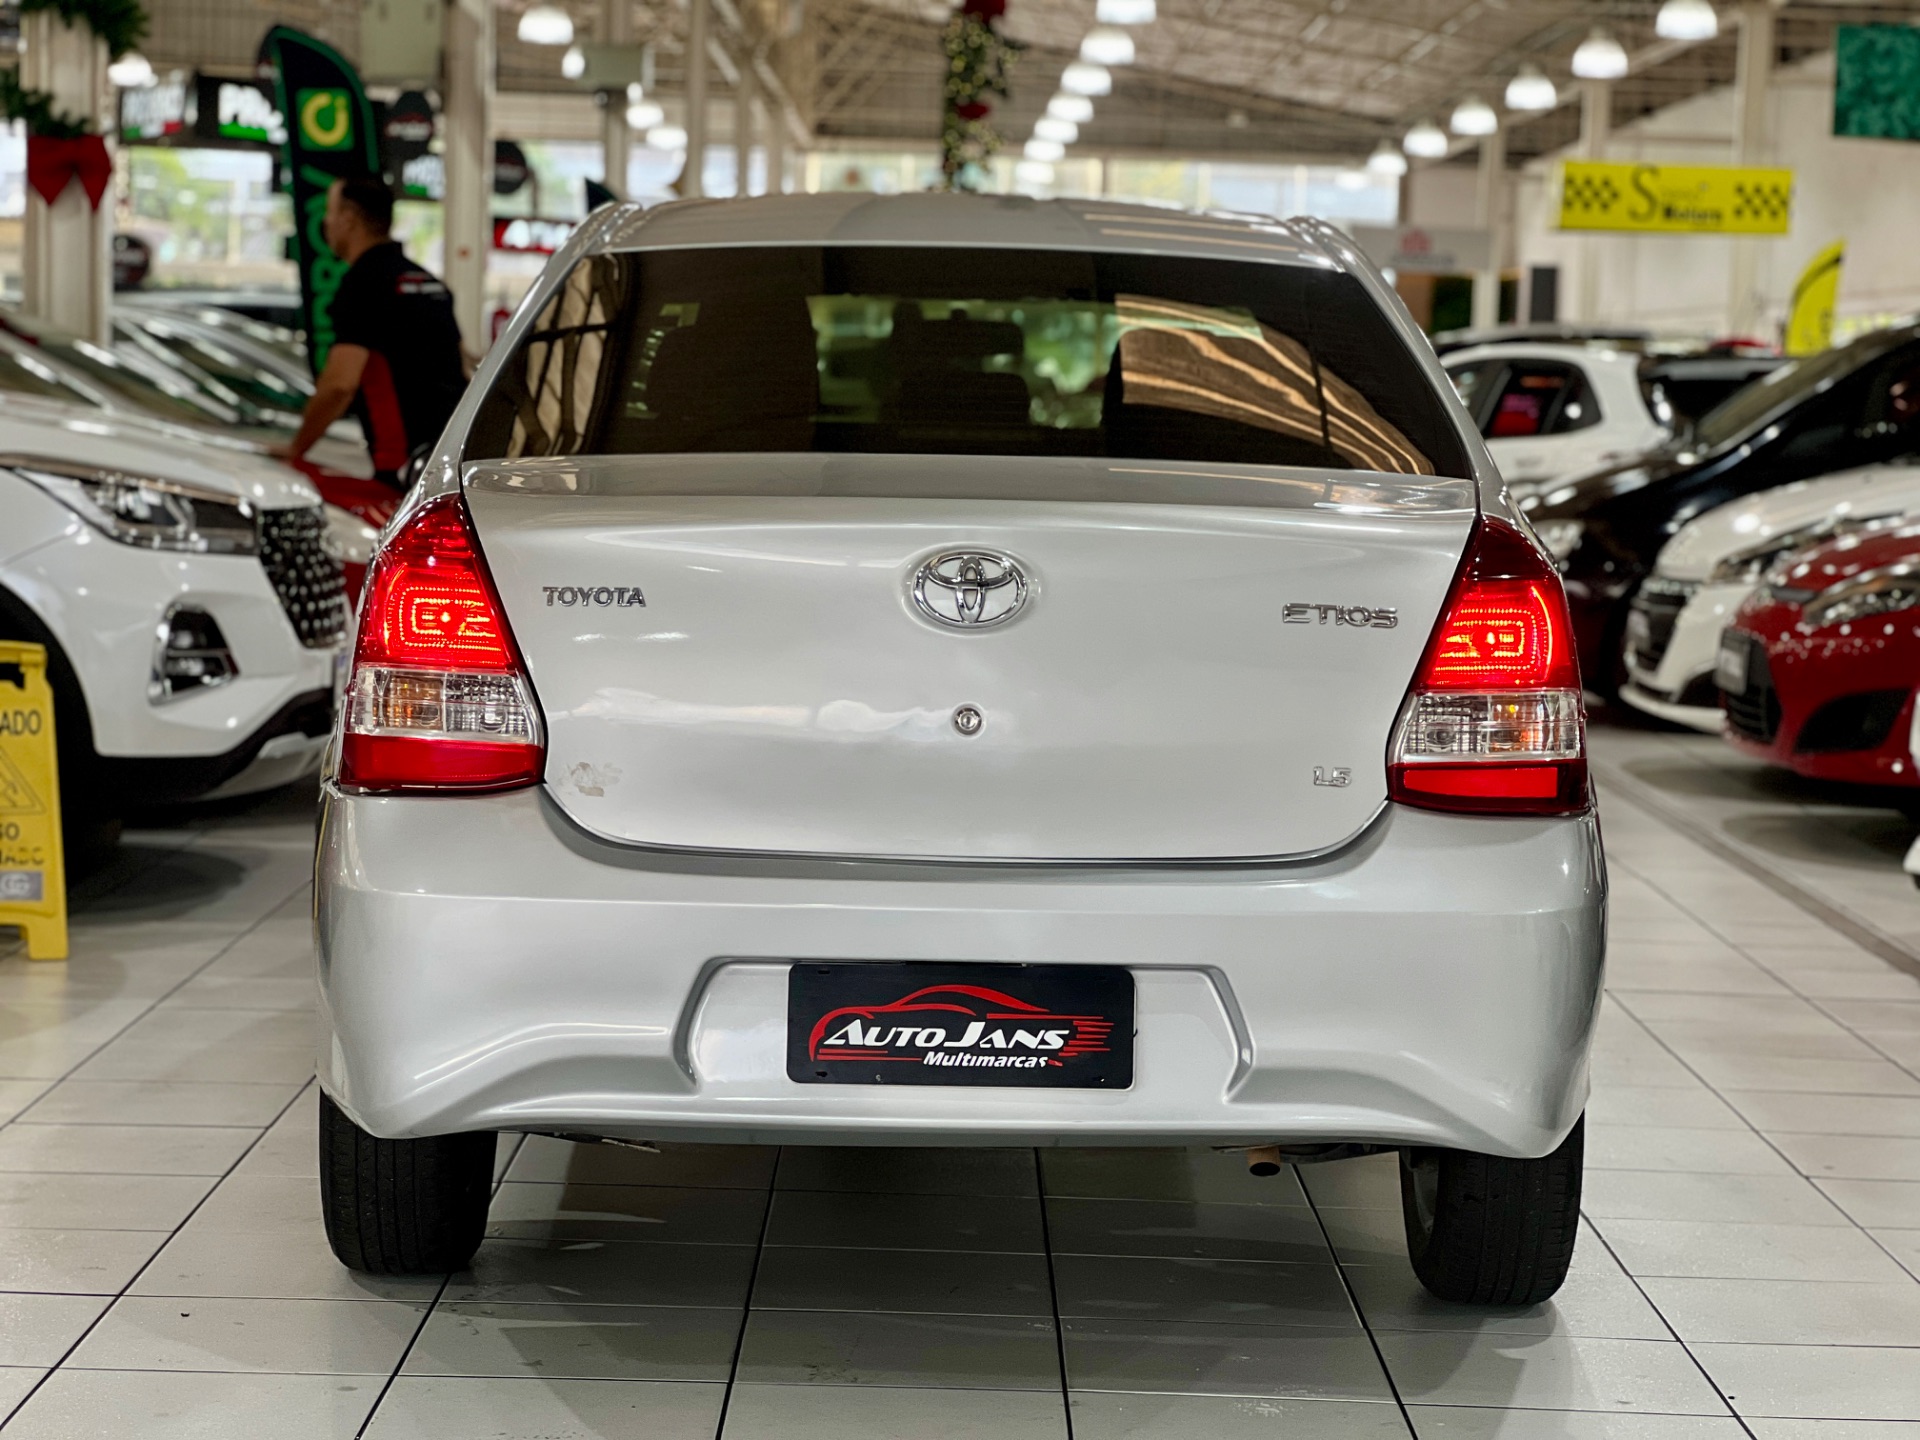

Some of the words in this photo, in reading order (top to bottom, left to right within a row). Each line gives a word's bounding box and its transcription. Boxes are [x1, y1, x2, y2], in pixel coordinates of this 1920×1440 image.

[542, 586, 646, 607] TOYOTA
[1282, 603, 1398, 628] ETIOS
[823, 1018, 947, 1048] AUTO
[944, 1021, 1070, 1050] JANS
[923, 1051, 1048, 1069] Multimarcas
